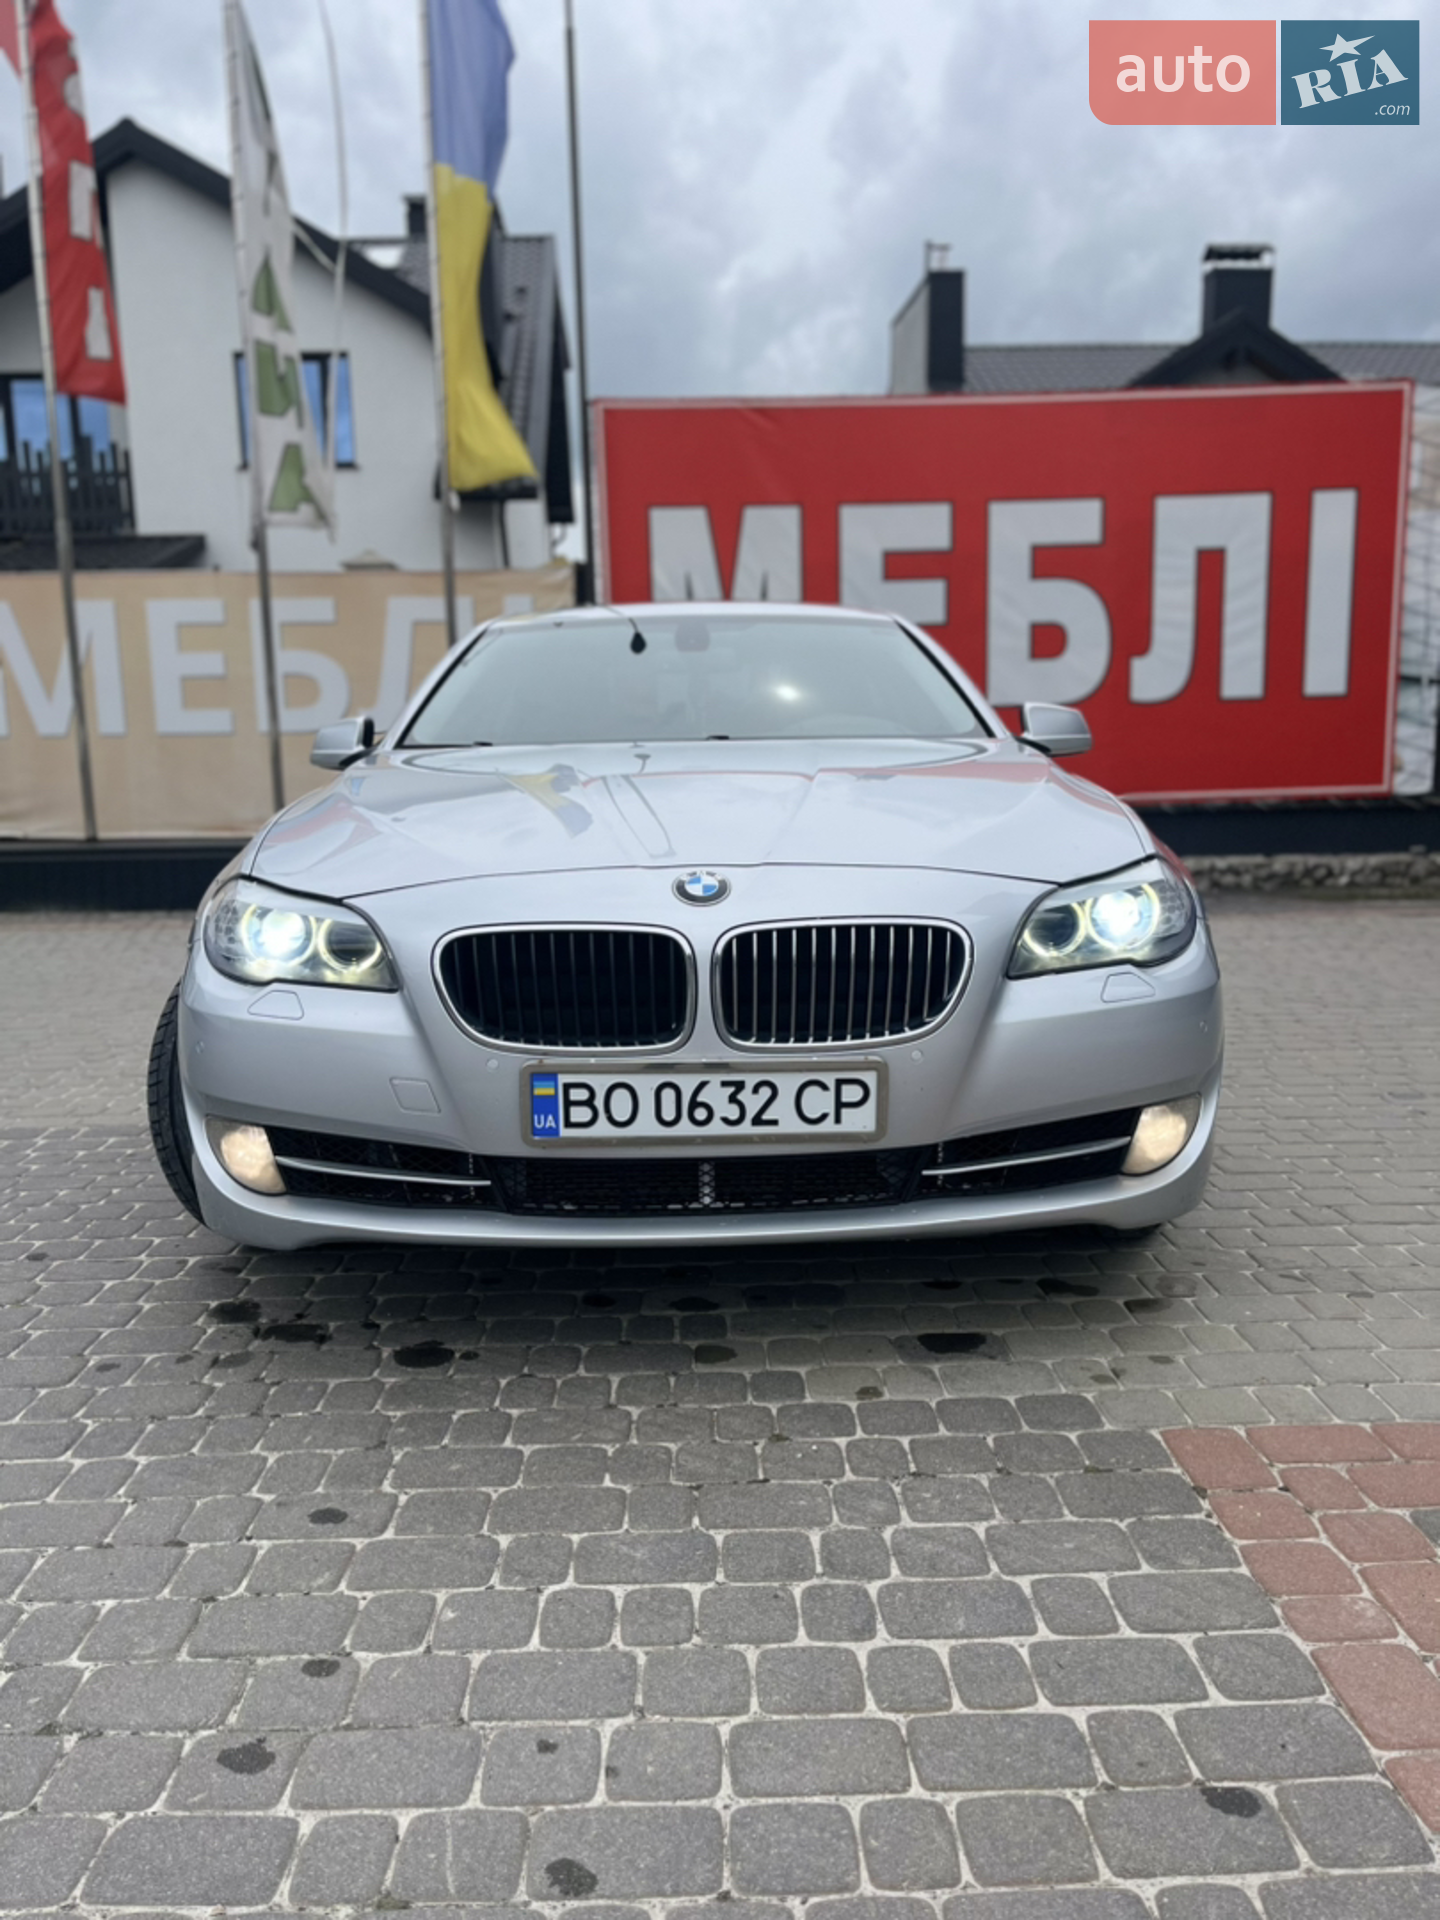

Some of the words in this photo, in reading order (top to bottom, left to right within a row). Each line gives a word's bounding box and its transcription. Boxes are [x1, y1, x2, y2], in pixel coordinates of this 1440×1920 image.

[0, 594, 534, 737] МЕБЛ
[533, 1114, 557, 1129] UA
[562, 1081, 639, 1129] BO
[653, 1079, 780, 1128] 0632
[794, 1077, 871, 1126] CP
